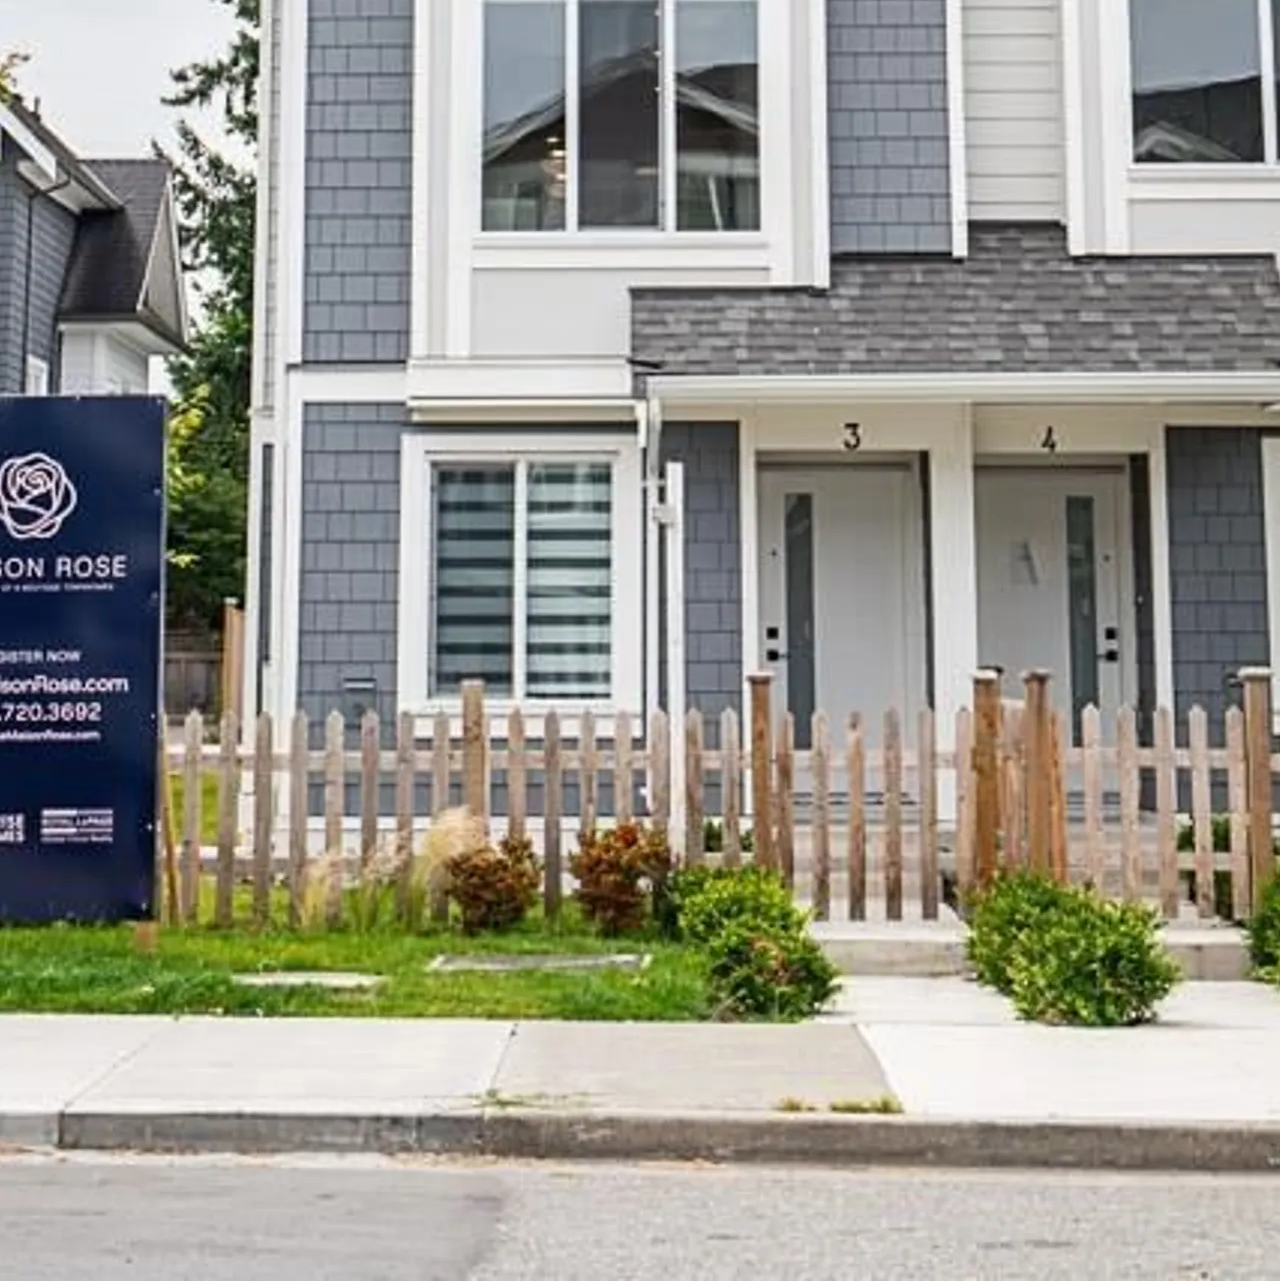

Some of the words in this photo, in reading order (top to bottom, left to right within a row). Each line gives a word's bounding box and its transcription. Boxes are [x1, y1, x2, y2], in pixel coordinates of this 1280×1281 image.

[843, 422, 861, 450] 3
[1041, 426, 1057, 452] 4
[55, 555, 128, 578] ROSE
[47, 649, 82, 663] NOW
